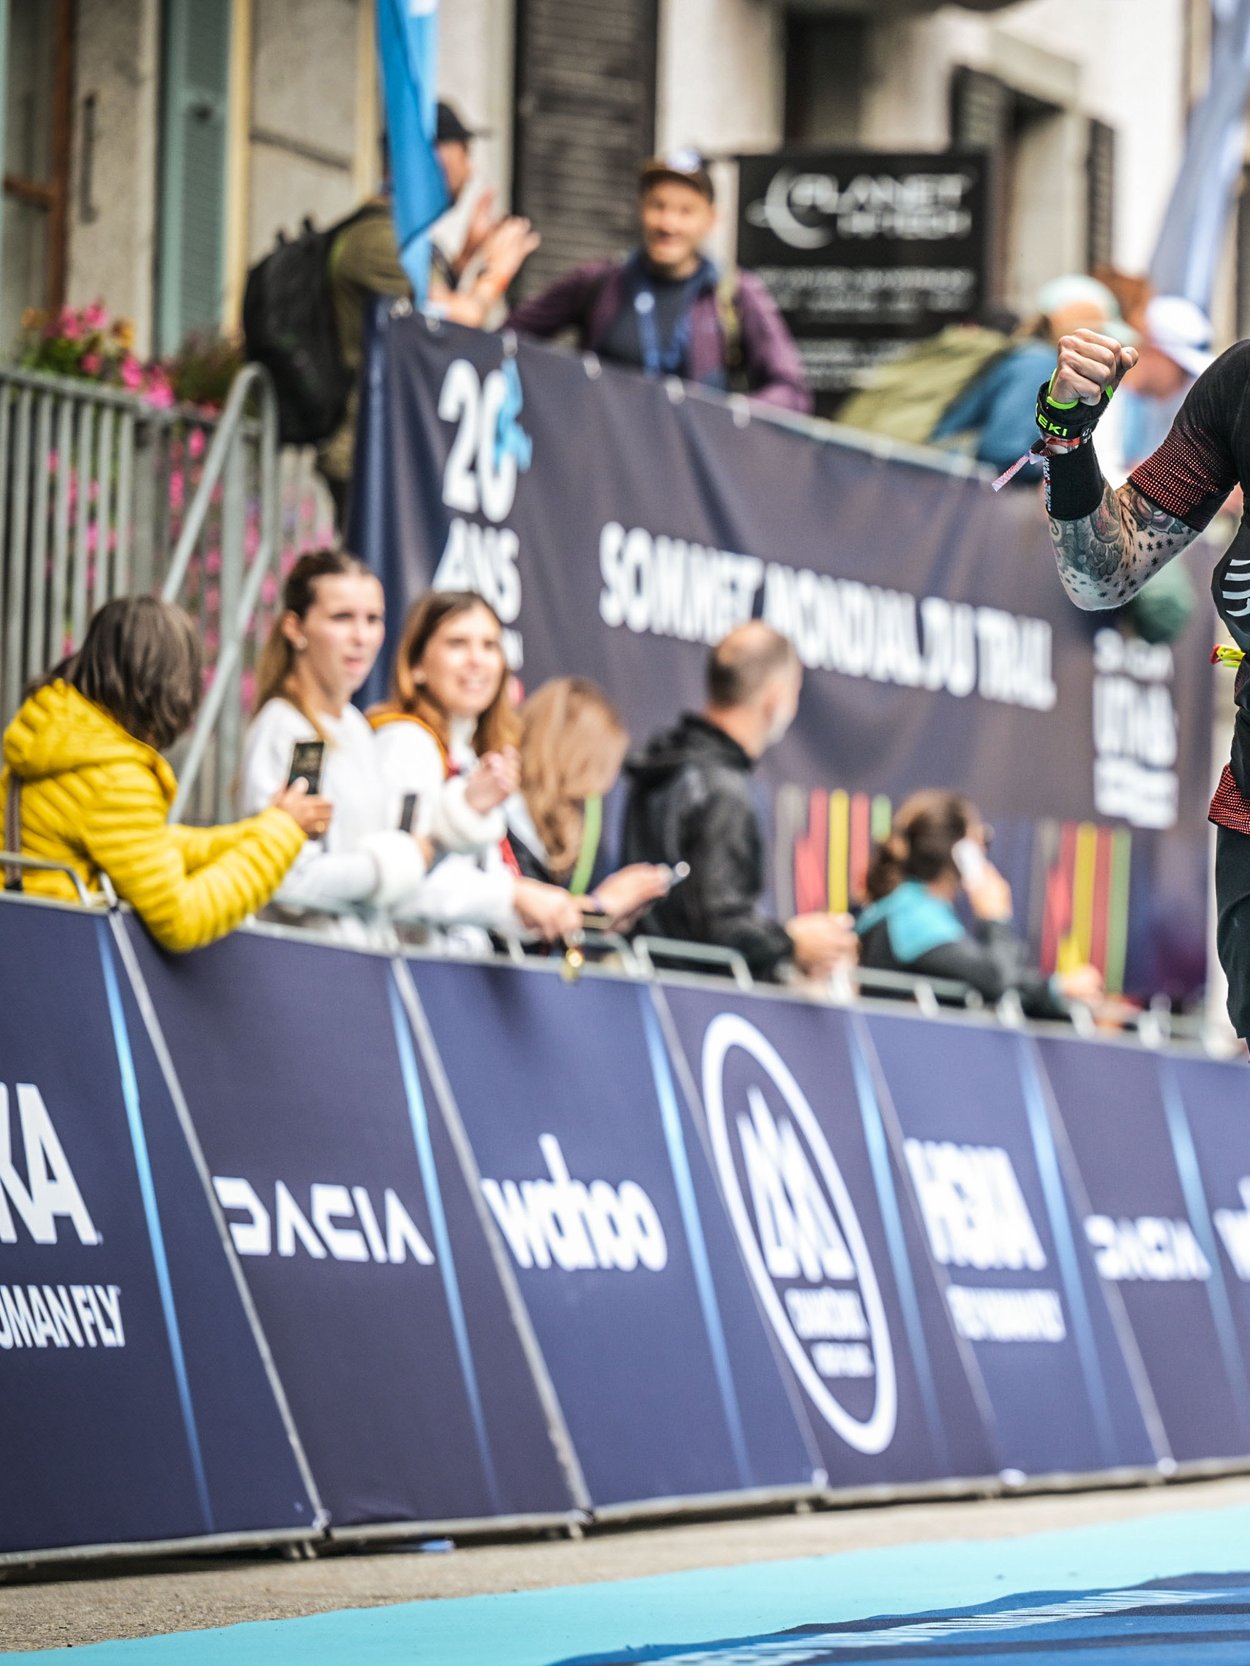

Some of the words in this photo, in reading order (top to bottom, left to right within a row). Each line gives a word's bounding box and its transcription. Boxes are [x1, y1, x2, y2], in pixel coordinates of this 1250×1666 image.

[1036, 402, 1068, 437] EKI
[600, 521, 764, 650] SOMMET
[763, 561, 926, 690] MONDIAL
[920, 596, 975, 699] DU
[975, 605, 1058, 713] TRAIL
[212, 1177, 435, 1265] DACIA
[482, 1133, 668, 1272] wahoo
[70, 1285, 126, 1348] FLY
